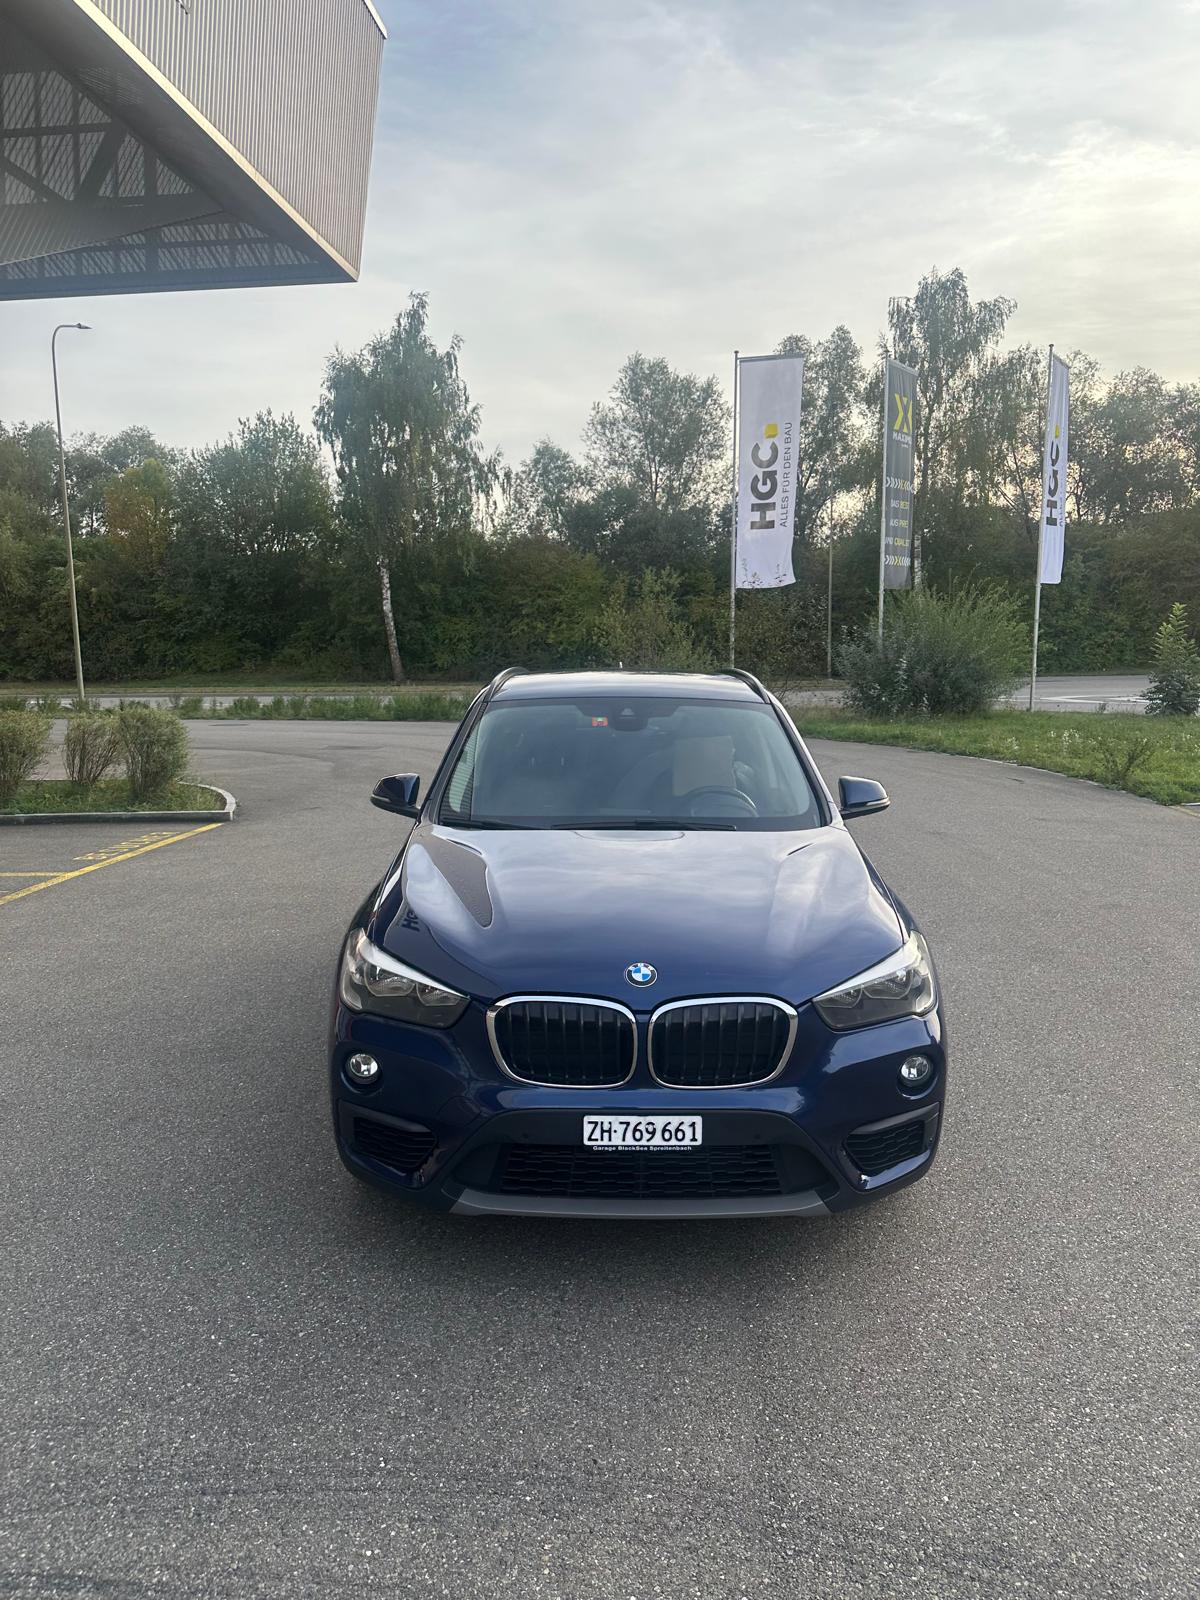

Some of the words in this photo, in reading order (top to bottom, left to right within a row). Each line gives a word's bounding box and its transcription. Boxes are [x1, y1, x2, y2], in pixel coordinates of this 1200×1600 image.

[784, 422, 793, 444] BAU
[783, 447, 792, 470] DEN
[750, 441, 779, 530] HGC
[780, 496, 790, 528] ALLES
